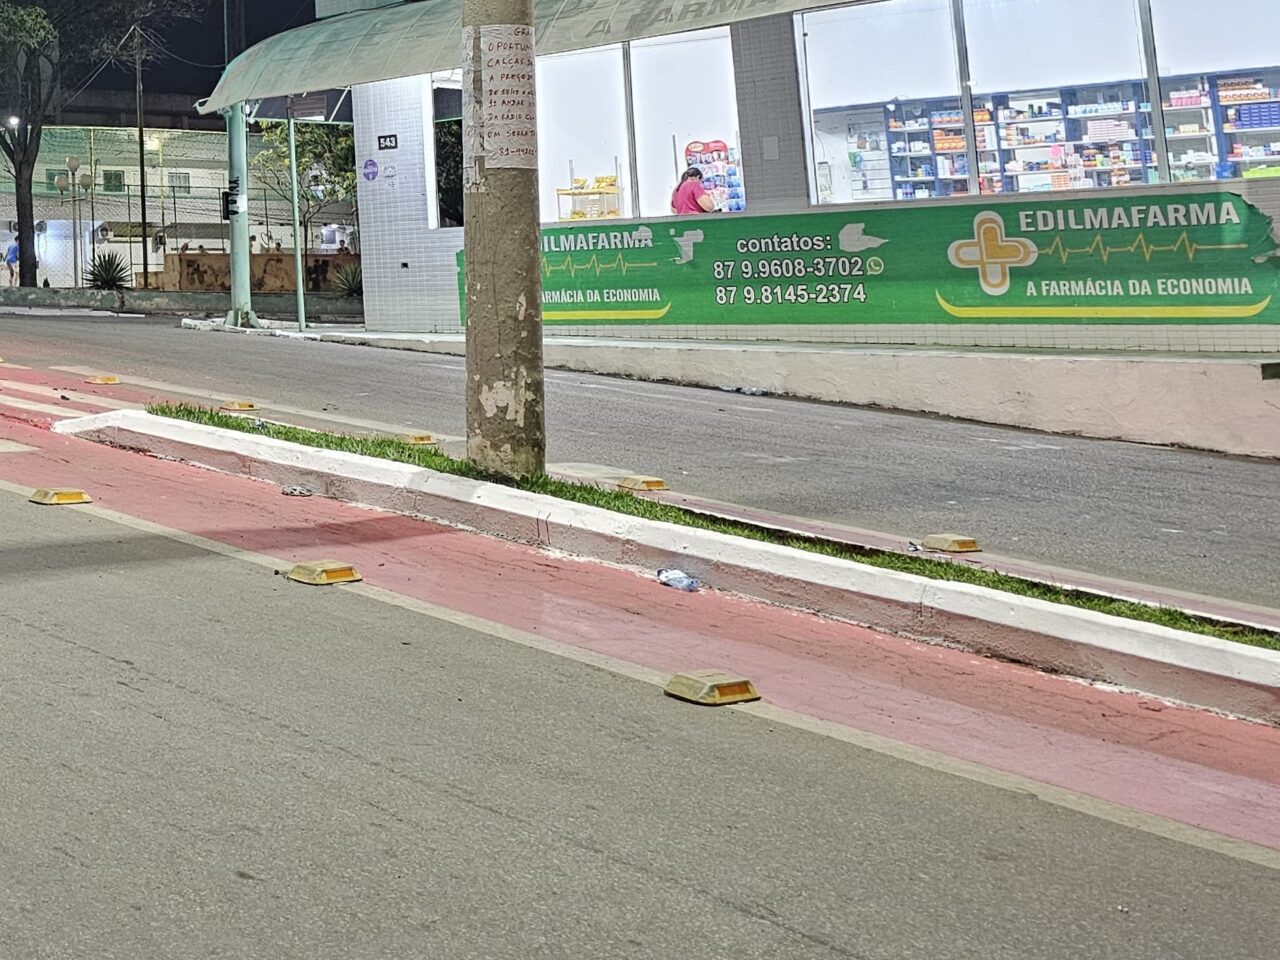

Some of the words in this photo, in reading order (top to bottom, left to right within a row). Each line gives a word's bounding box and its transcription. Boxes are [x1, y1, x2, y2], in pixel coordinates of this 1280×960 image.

[379, 137, 396, 148] 543
[1019, 201, 1241, 233] EDILMAFARMA
[737, 233, 832, 253] contatos:
[713, 260, 735, 279] 87
[741, 257, 863, 279] 9.9608-3702
[587, 289, 601, 302] DA
[604, 288, 661, 302] ECONOMIA
[715, 286, 737, 304] 87
[743, 283, 867, 304] 9.8145-2374
[1026, 281, 1037, 296] A
[1041, 276, 1124, 296] FARMÁCIA
[1128, 280, 1152, 295] DA
[1157, 277, 1253, 295] ECONOMIA
